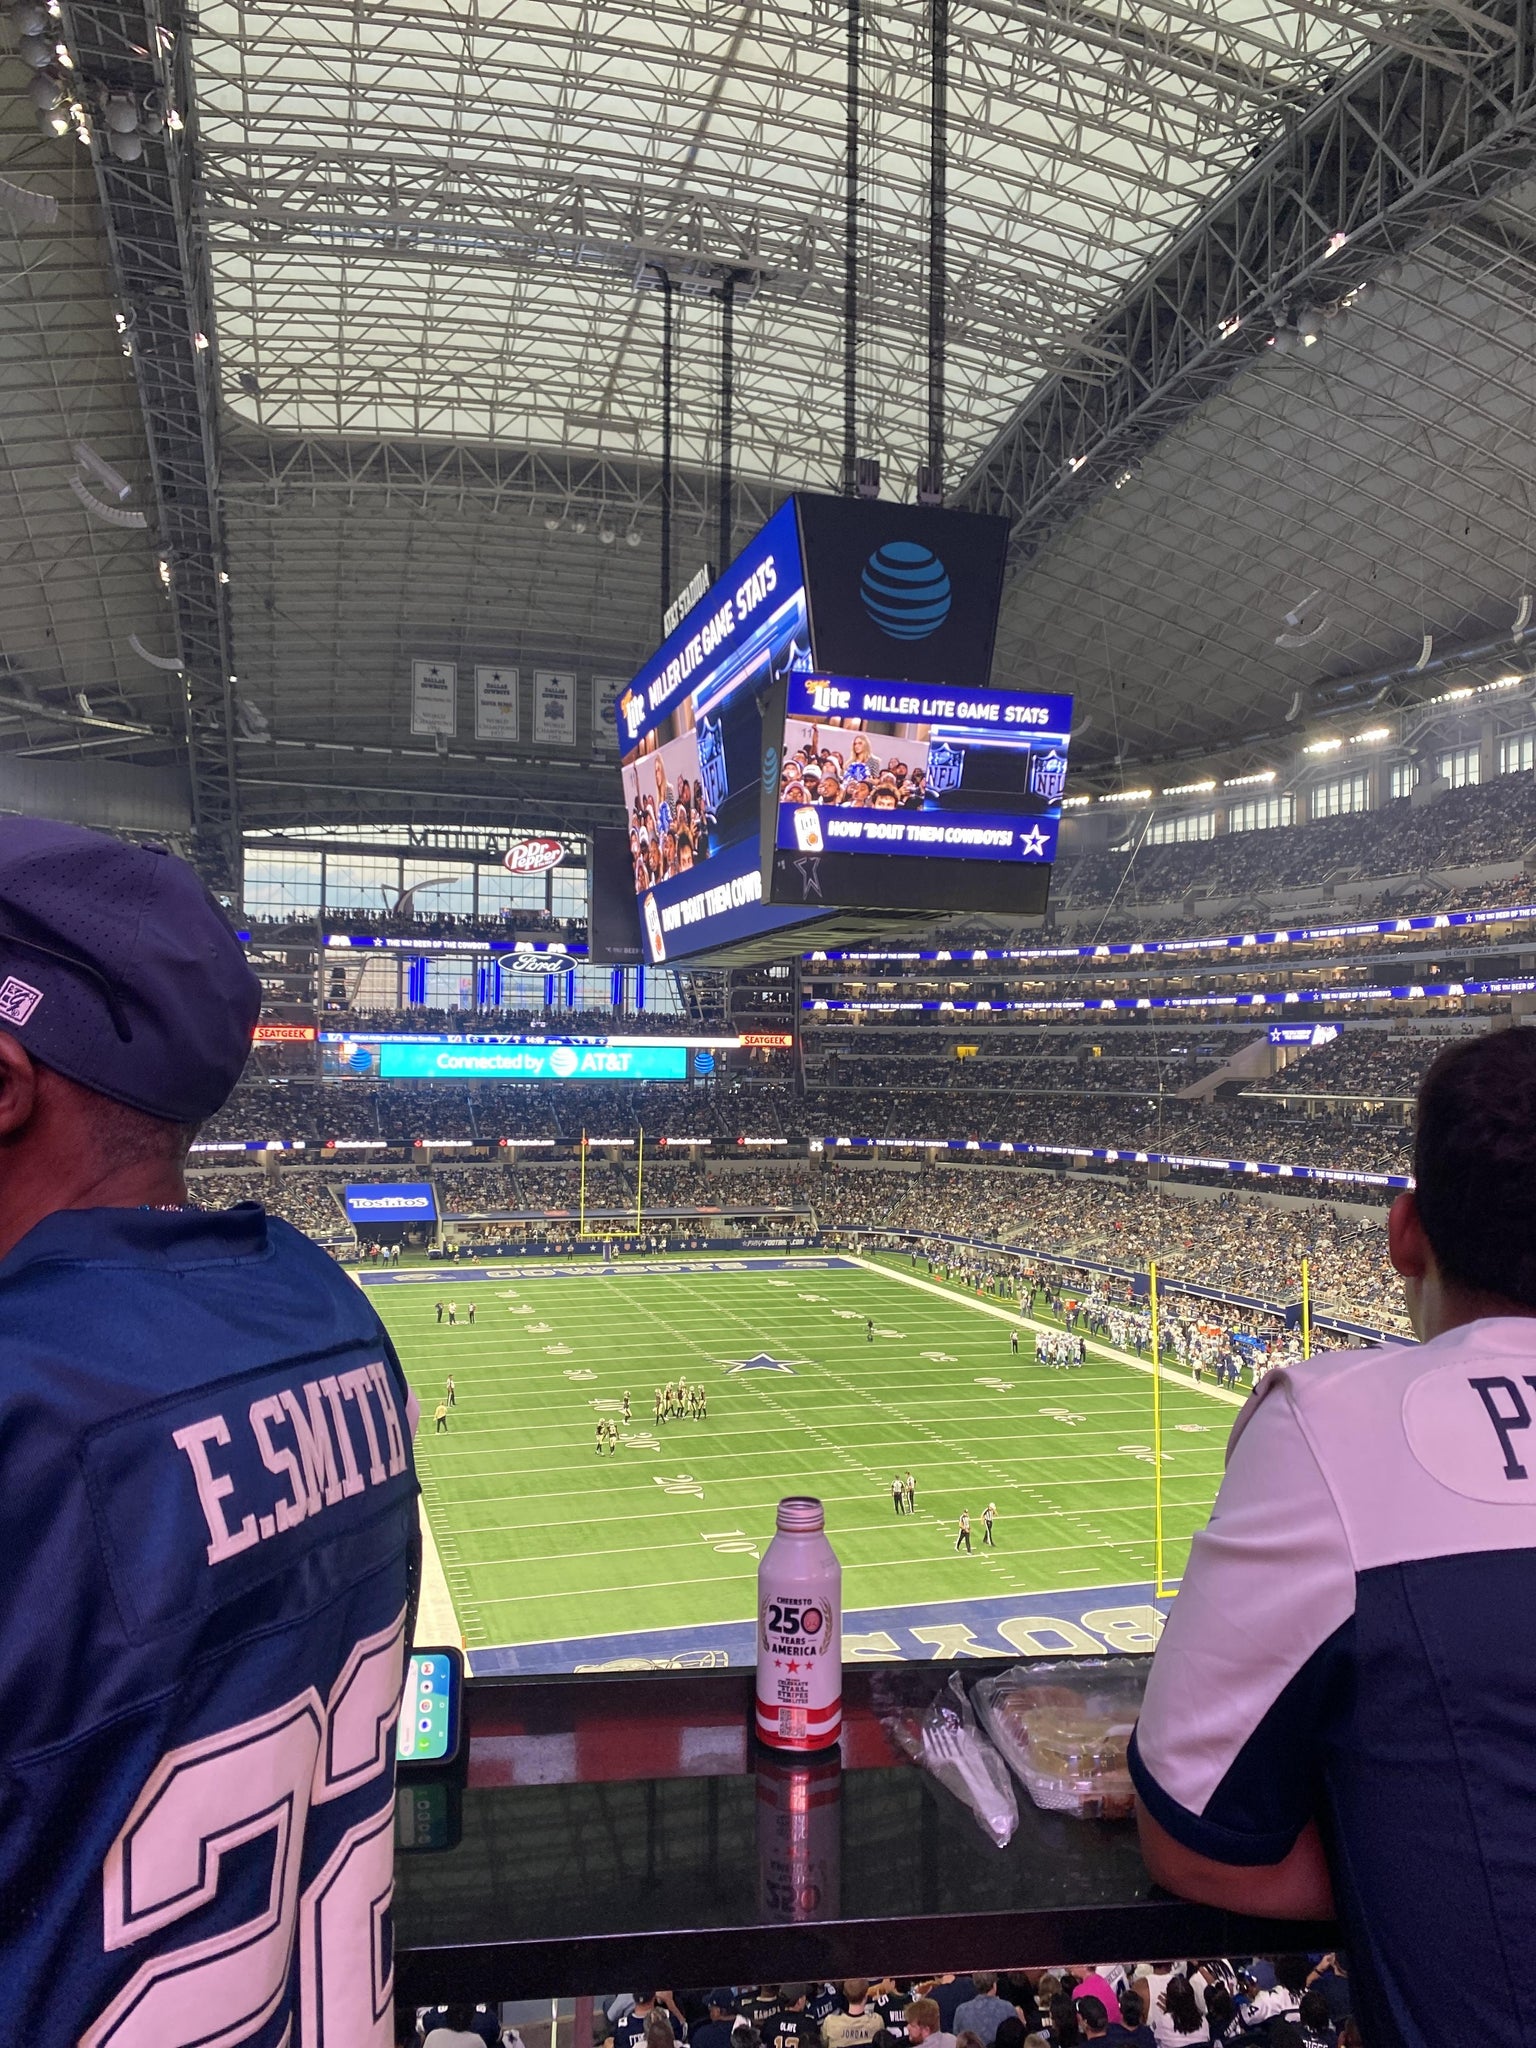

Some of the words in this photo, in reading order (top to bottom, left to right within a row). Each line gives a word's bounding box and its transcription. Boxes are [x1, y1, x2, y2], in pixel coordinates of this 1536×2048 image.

[678, 563, 711, 618] STADIUM
[648, 657, 683, 711] MILLER
[681, 632, 704, 680] LITE
[701, 600, 736, 656] GAME
[736, 555, 778, 621] STATS
[812, 686, 851, 713] Lite
[863, 694, 920, 715] MILLER
[922, 699, 956, 718] LITE
[957, 702, 1000, 722] GAME
[1004, 706, 1050, 725] STATS
[928, 764, 956, 788] NFL
[828, 820, 863, 838] HOW
[907, 825, 946, 844] THEM
[945, 827, 1013, 847] COWBOYS!
[511, 844, 561, 870] Pepper
[528, 842, 549, 857] Dr
[662, 905, 682, 932] HOW
[704, 883, 733, 917] THEM
[1496, 911, 1510, 919] BEER
[1519, 908, 1530, 916] THE
[512, 953, 564, 973] Ford
[258, 1029, 306, 1038] SEATGEEK
[744, 1035, 786, 1045] SEATGEEK
[437, 1054, 524, 1071] Connected
[525, 1054, 545, 1075] by
[581, 1053, 633, 1072] AT&T
[486, 1262, 748, 1279] COWBOYS
[1467, 1375, 1536, 1480] P
[172, 1361, 408, 1566] E.SMITH
[777, 1596, 802, 1606] CHEERS
[803, 1598, 813, 1606] TO
[768, 1604, 823, 1636] 250
[771, 1643, 817, 1656] AMERICA
[780, 1636, 806, 1645] YEARS
[777, 1690, 809, 1699] STRIPES
[779, 2021, 798, 2033] OLAVE
[840, 2029, 870, 2040] JORDAN
